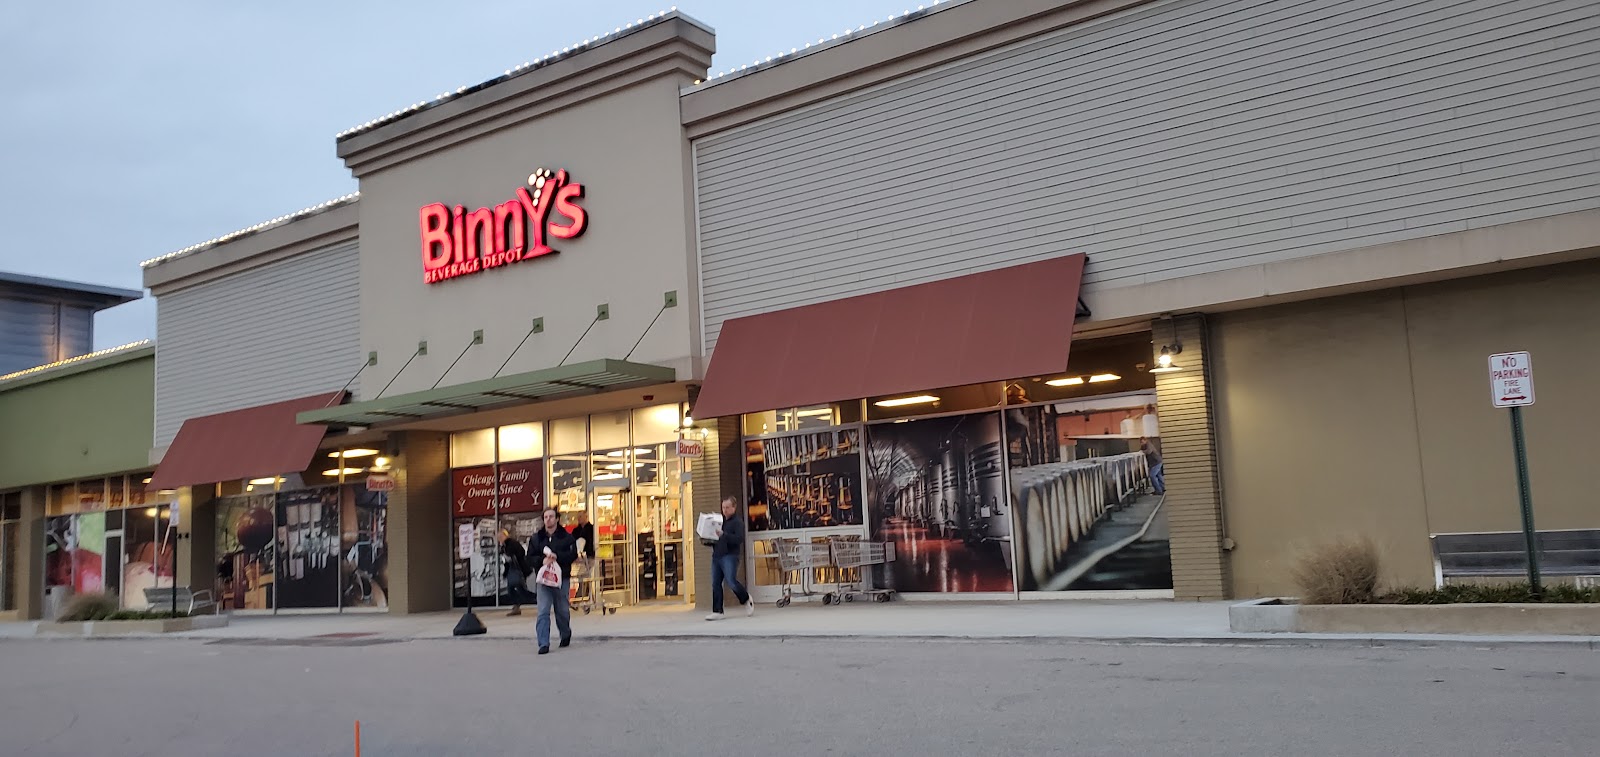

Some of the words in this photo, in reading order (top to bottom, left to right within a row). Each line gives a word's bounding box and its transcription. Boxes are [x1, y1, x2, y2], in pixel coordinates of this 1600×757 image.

[424, 259, 480, 284] BEVERAGE
[482, 247, 524, 270] DEPOT
[1502, 356, 1517, 368] NO
[1493, 368, 1529, 380] PARKING
[1503, 387, 1522, 395] LANE
[499, 469, 530, 482] Family
[499, 483, 524, 495] Since
